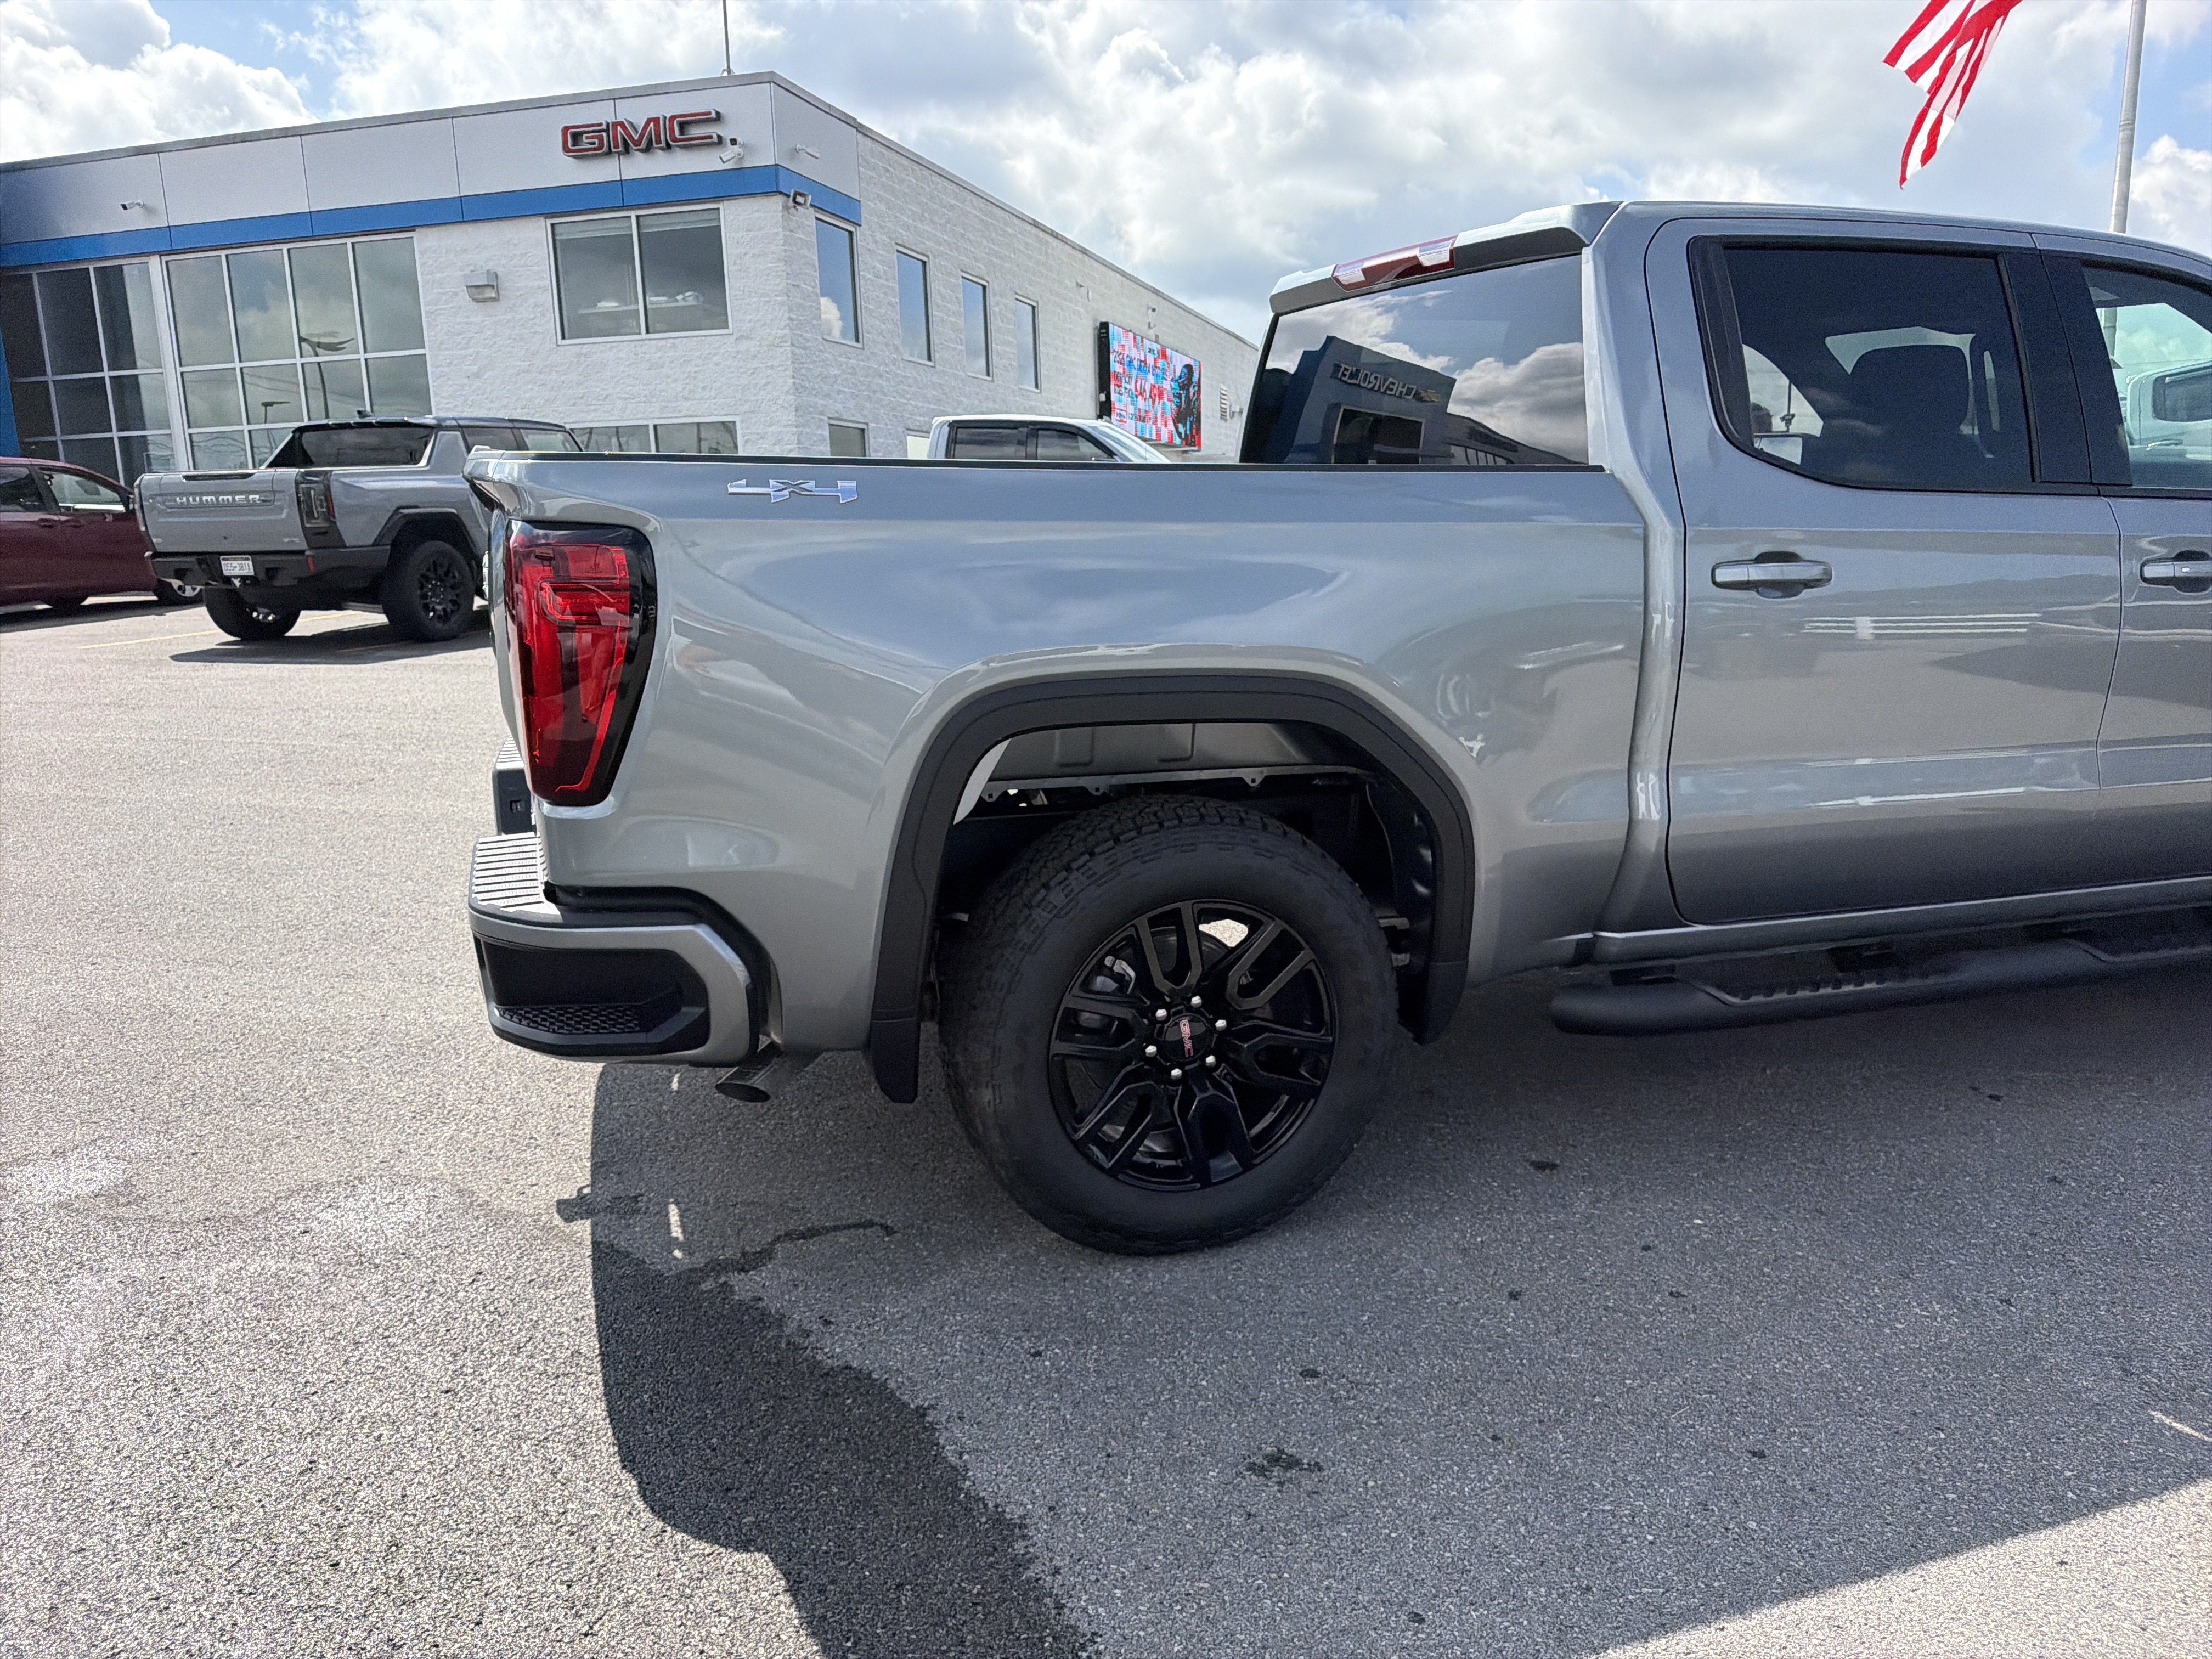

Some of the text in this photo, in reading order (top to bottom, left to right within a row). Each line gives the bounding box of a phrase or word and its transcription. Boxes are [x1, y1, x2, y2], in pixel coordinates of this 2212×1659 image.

[561, 109, 720, 157] GMC
[176, 495, 261, 505] HUMMER
[1180, 1019, 1194, 1058] GMC
